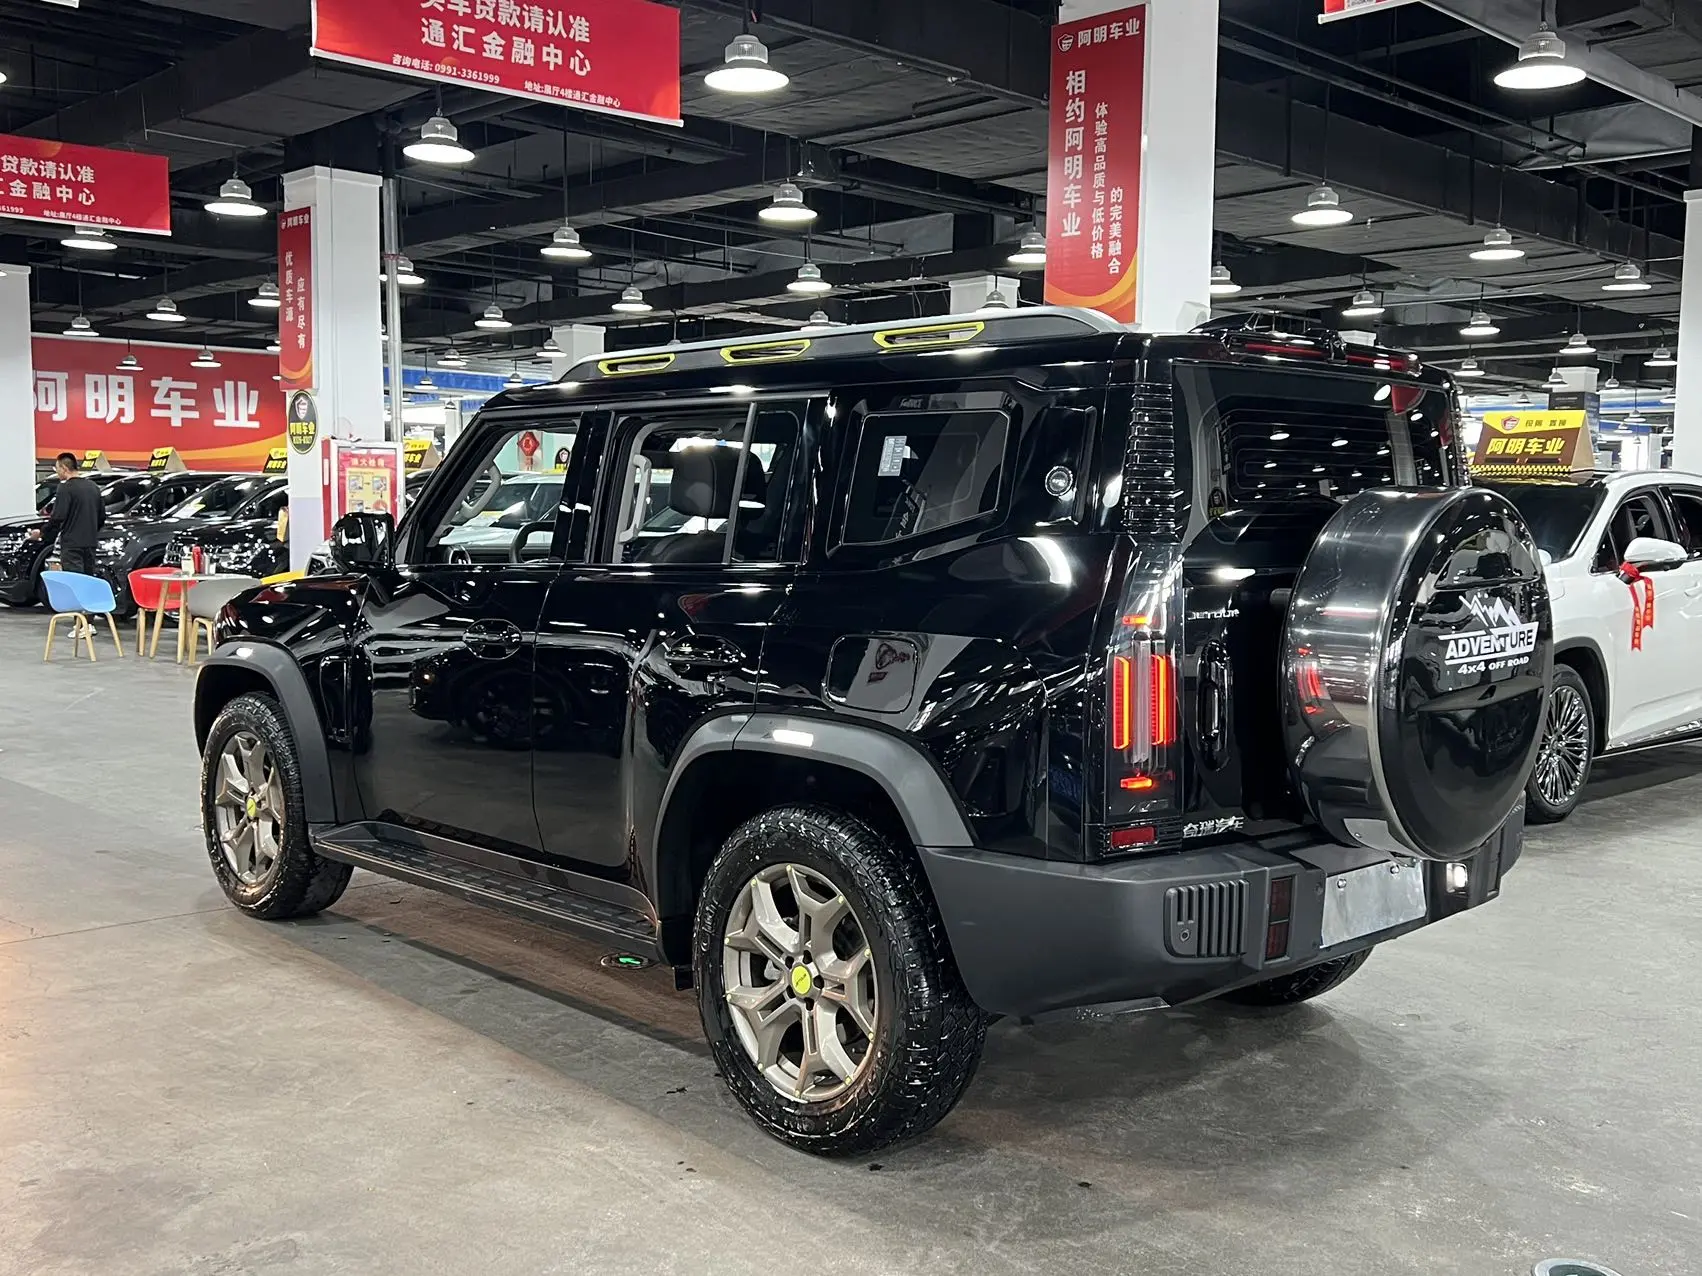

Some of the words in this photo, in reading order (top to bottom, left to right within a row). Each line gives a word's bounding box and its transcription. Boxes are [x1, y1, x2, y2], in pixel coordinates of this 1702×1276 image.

[421, 17, 591, 76] 通汇金融中心
[1077, 18, 1140, 48] 阿明车业
[0, 154, 95, 183] 贷款请认准
[1061, 70, 1086, 238] 相约阿明车业
[0, 177, 95, 206] 金融中心
[1091, 102, 1108, 259] 体验高品质与低价格
[1108, 186, 1123, 275] 的完美融合
[1486, 438, 1565, 455] 阿明车业
[1445, 628, 1534, 659] ADVENTURE
[1489, 661, 1506, 670] OFF
[1507, 656, 1530, 667] ROAD
